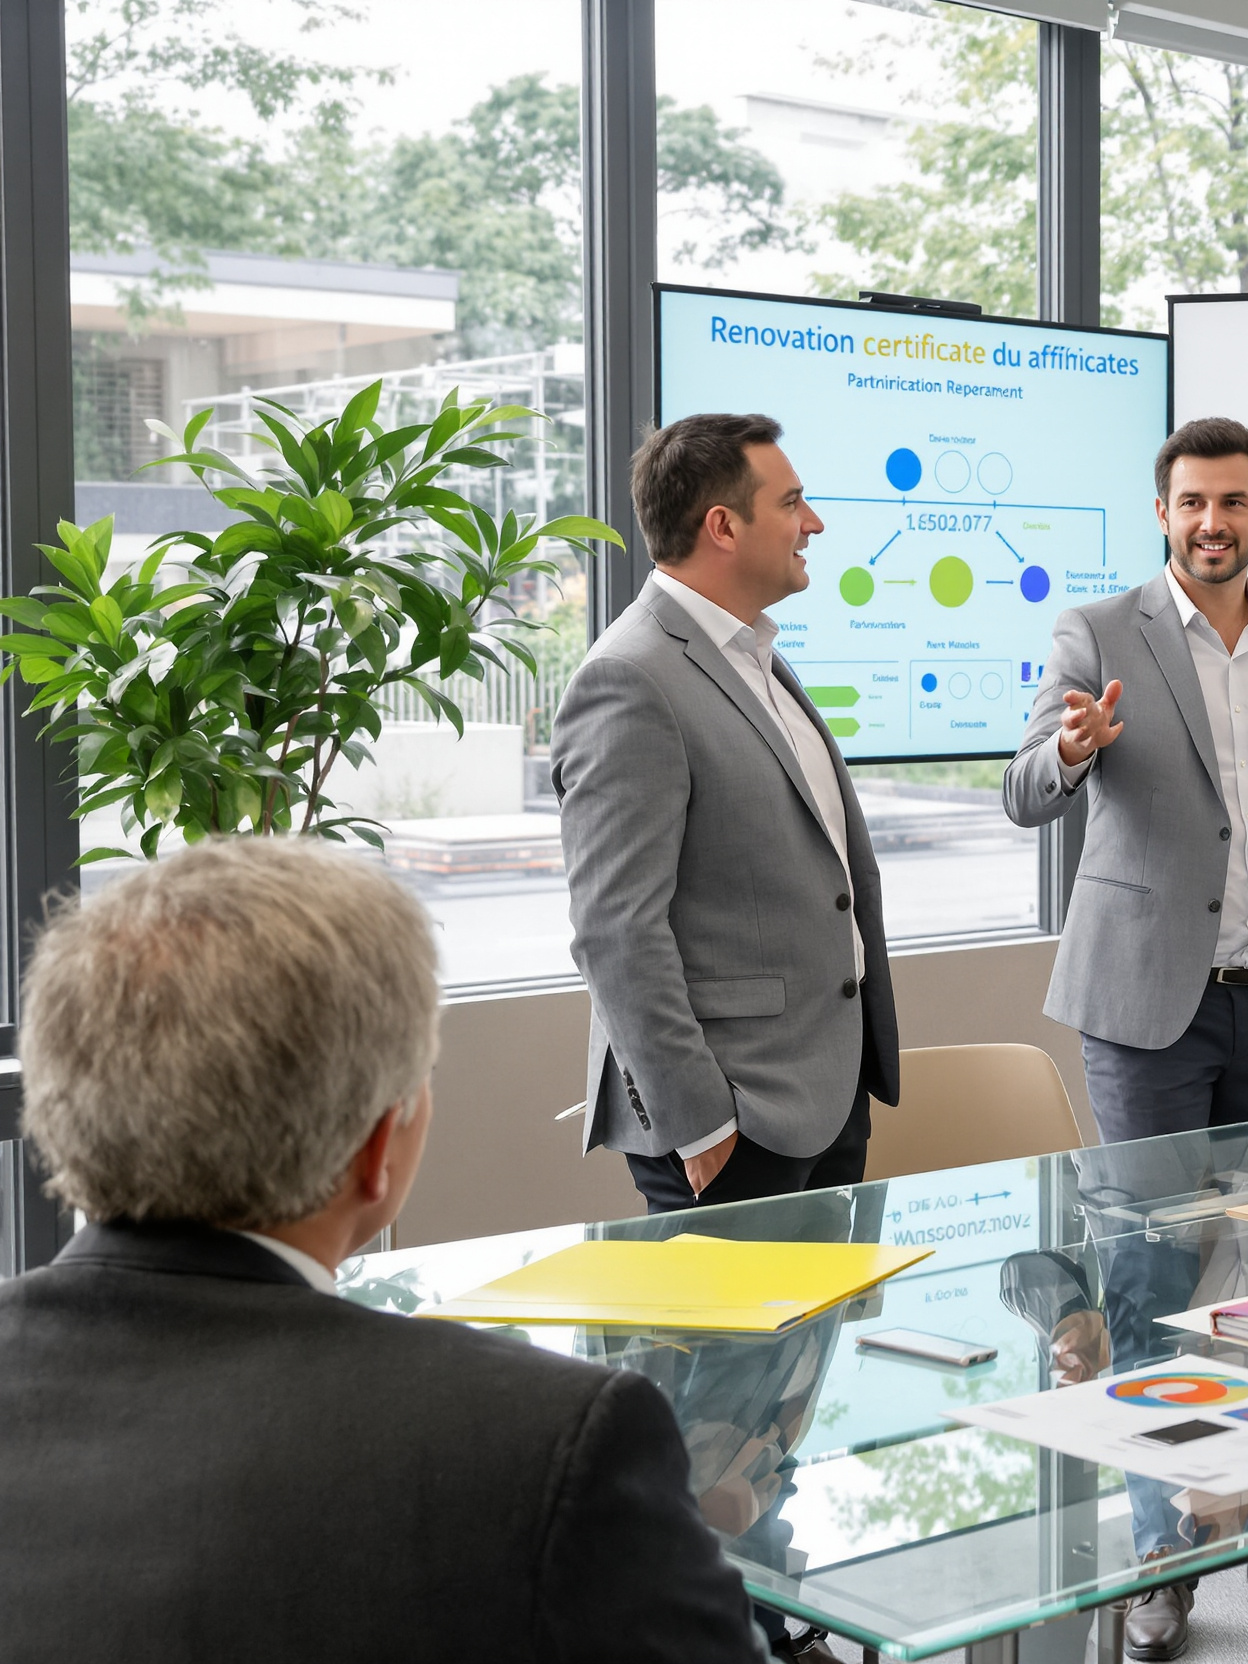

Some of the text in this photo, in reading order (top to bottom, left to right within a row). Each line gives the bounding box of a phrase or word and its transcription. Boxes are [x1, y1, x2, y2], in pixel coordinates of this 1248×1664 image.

[711, 316, 854, 354] Renovation
[863, 333, 986, 364] certificate
[992, 342, 1021, 367] du
